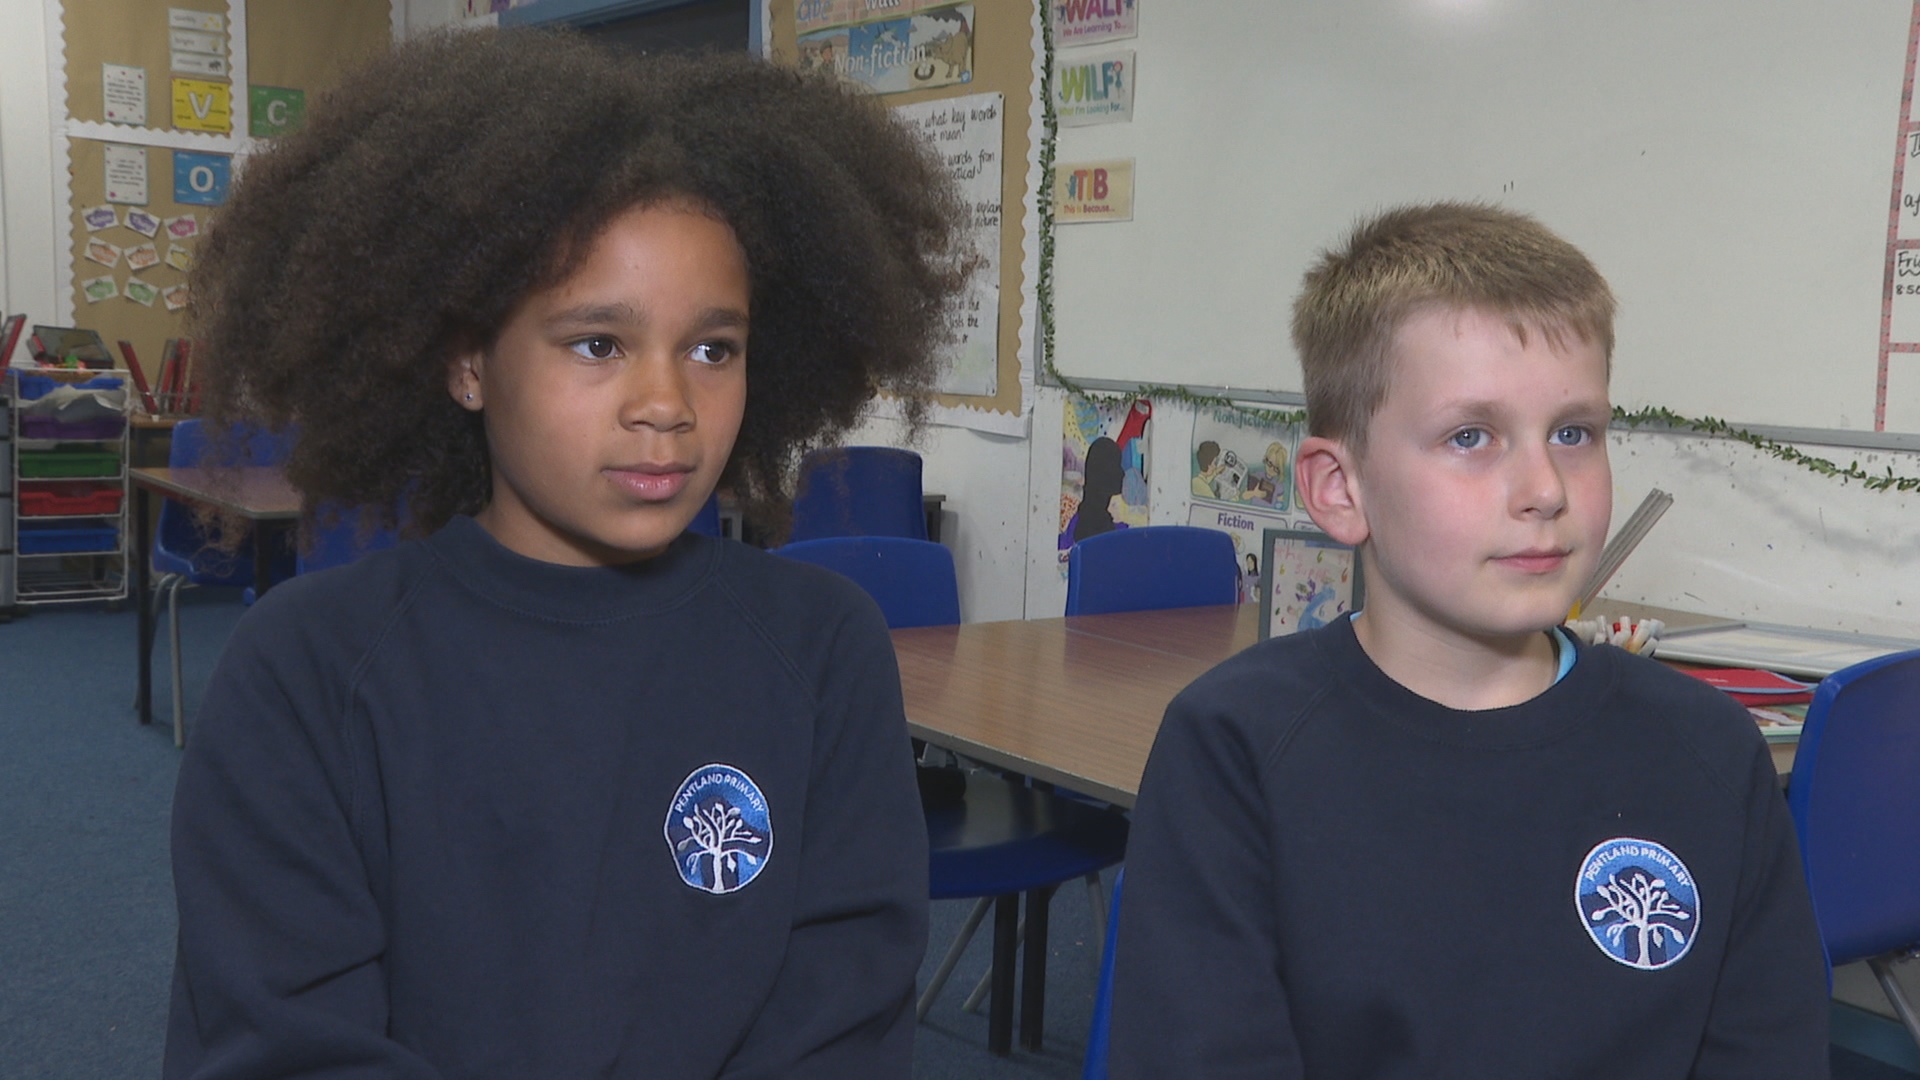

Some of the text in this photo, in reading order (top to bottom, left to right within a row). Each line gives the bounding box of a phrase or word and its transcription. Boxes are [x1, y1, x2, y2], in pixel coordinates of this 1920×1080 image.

[1063, 28, 1072, 37] We
[1073, 26, 1083, 36] Are
[1084, 22, 1112, 34] Learning
[833, 43, 927, 77] Non-fiction
[1061, 61, 1114, 104] WILF
[188, 91, 214, 120] V
[267, 99, 288, 126] C
[925, 108, 947, 128] what
[951, 107, 966, 132] key
[970, 104, 997, 122] words
[1086, 104, 1109, 115] Looking
[948, 150, 973, 166] words
[977, 148, 995, 174] from
[189, 165, 215, 193] O
[1073, 168, 1108, 201] TIB
[1064, 204, 1075, 214] This
[1076, 205, 1082, 213] is
[1217, 513, 1255, 531] Fiction
[674, 773, 765, 813] PENTLAND PRIMARY
[1585, 845, 1691, 887] PENTLAND PRIMARY
